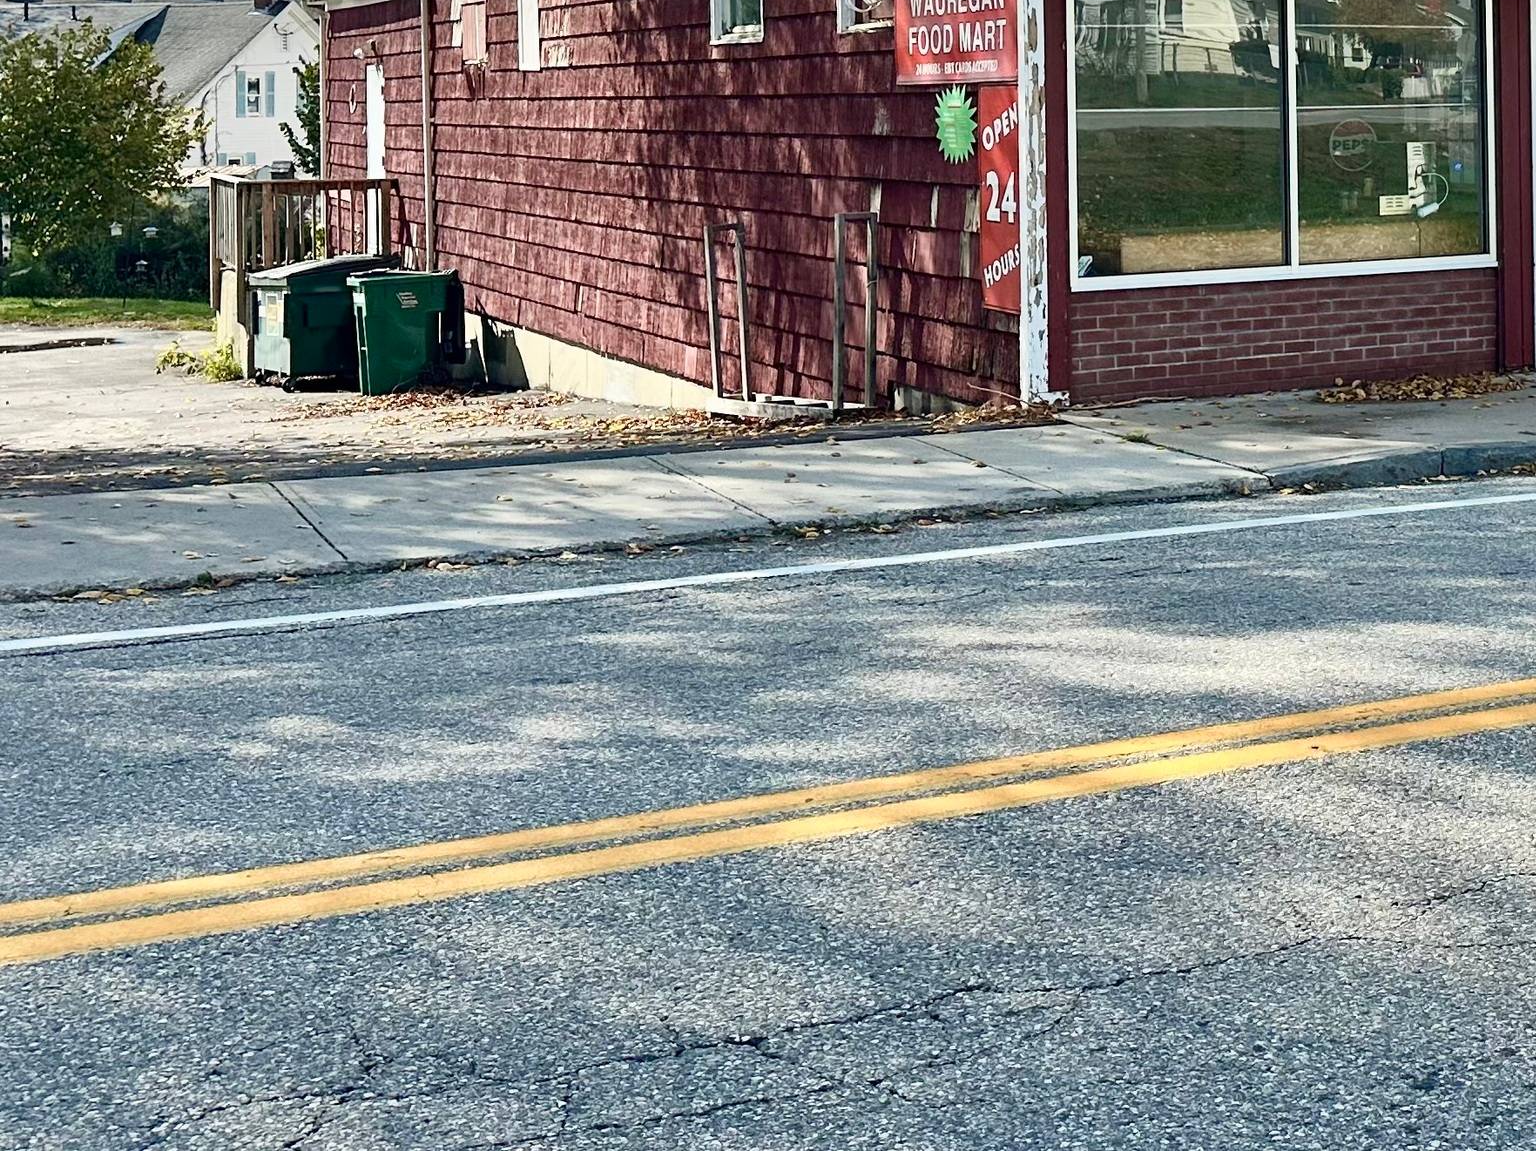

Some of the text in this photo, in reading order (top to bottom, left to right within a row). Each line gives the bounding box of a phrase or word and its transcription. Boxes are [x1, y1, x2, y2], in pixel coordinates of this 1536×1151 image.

[908, 19, 1007, 55] FOOD MART
[982, 101, 1019, 151] OPEN
[986, 170, 1017, 224] 24
[984, 244, 1020, 289] HOURS
